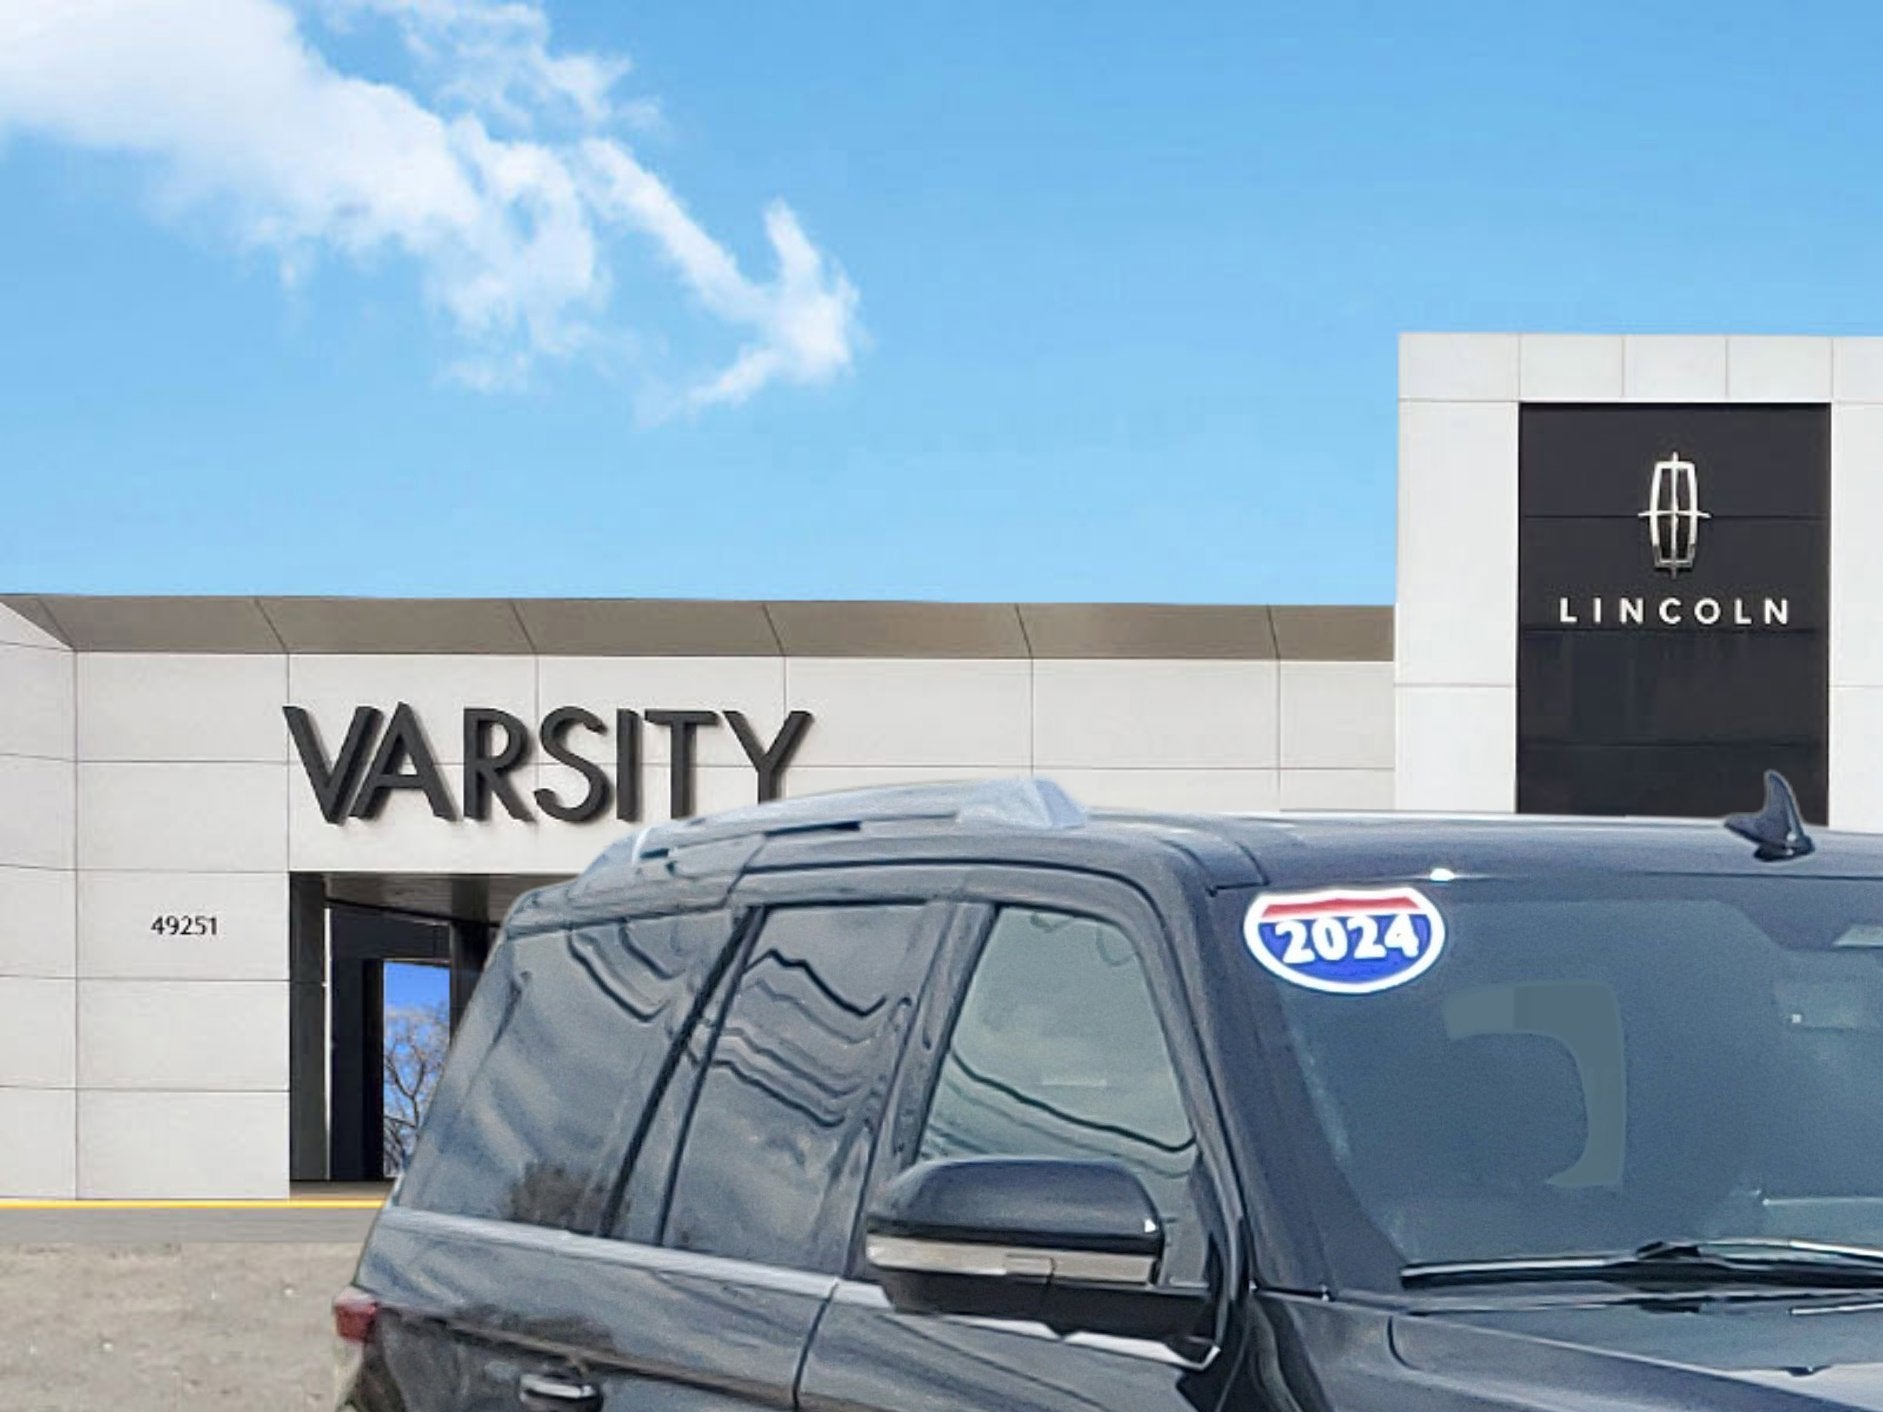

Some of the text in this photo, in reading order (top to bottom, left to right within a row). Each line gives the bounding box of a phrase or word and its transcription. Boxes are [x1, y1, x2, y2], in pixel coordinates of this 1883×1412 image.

[1558, 597, 1789, 625] LINCOLN
[281, 701, 813, 826] VARSITY
[150, 915, 217, 936] 49251
[1274, 914, 1420, 964] 2024
